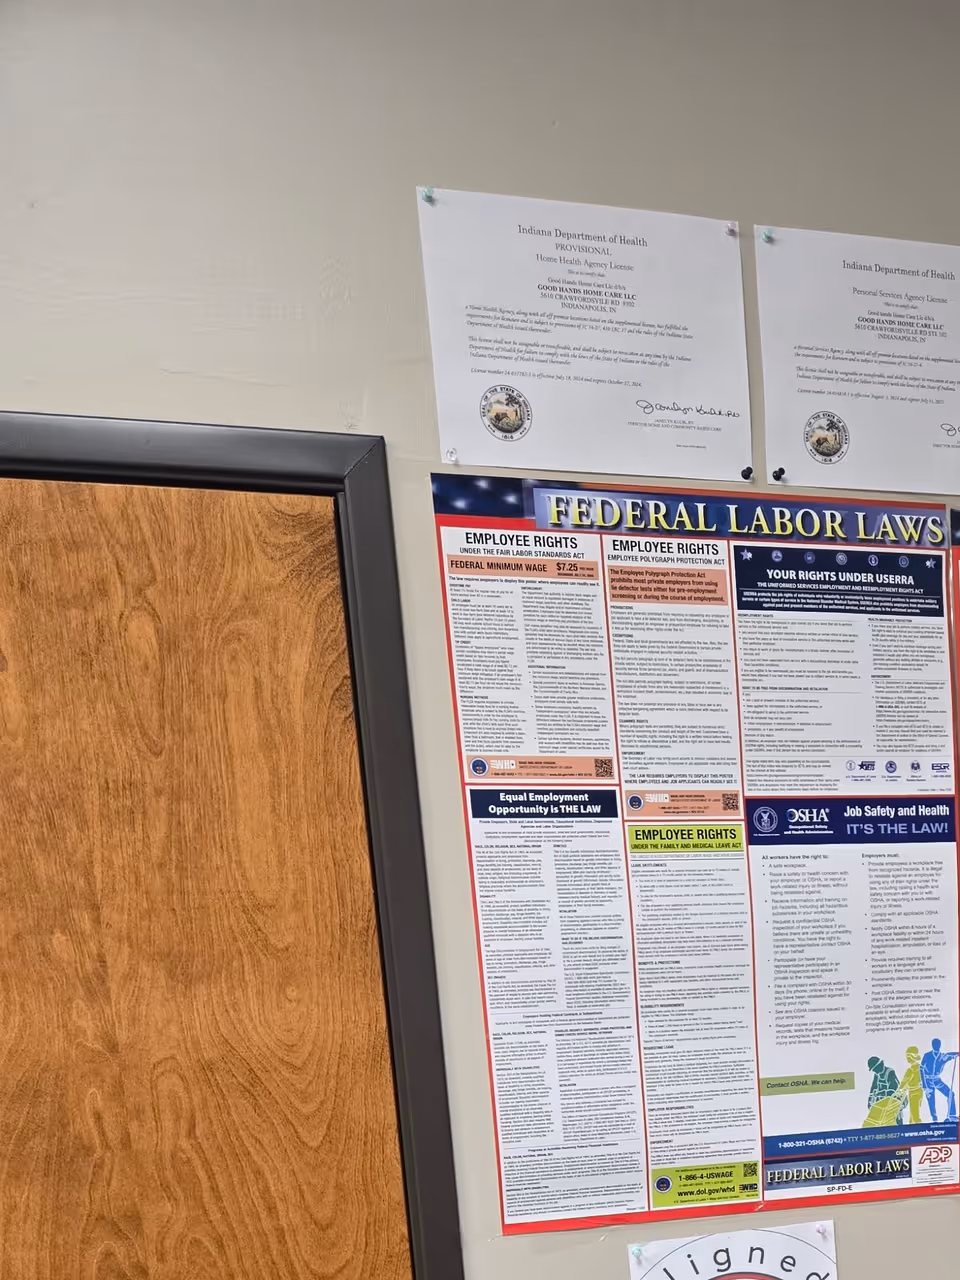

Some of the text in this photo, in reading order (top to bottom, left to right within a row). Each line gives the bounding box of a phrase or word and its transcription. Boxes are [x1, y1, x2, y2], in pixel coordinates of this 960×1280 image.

[518, 224, 648, 247] Indiana Department of Health
[555, 243, 612, 256] PROVISIONAL
[536, 254, 634, 271] Home Health Agency License
[842, 260, 956, 280] Indiana Department of Health
[537, 284, 558, 294] GOOD
[558, 286, 582, 294] HANDS
[583, 289, 603, 297] HOME
[852, 287, 948, 304] Personal Services Agency License
[548, 494, 944, 543] FEDERAL LABOR LAWS
[465, 532, 578, 549] EMPLOYEE RIGHTS
[612, 539, 719, 555] EMPLOYEE RIGHTS
[496, 548, 510, 558] FAIR
[512, 549, 533, 559] LABOR
[534, 551, 572, 559] STANDARDS
[608, 554, 638, 562] EMPLOYEE
[640, 555, 675, 563] POLYGRAPH
[676, 557, 712, 565] PROTECTION
[450, 560, 547, 572] FEDERAL MINIMUM WAGE
[556, 562, 578, 572] $7.25
[766, 569, 914, 585] YOUR RIGHTS UNDER USERRA
[500, 792, 589, 803] Equal Employment
[488, 802, 601, 816] Opportunity Is THE LAW
[786, 808, 829, 822] OSHA
[844, 805, 950, 818] Job Safety and Health
[635, 828, 736, 840] EMPLOYEE RIGHTS
[846, 822, 948, 835] IT'S THE LAW!
[778, 1139, 825, 1148] 1-800-321-OSHA
[918, 1146, 953, 1164] ADP
[678, 1171, 734, 1181] 1-866-4-USWAGE
[766, 1158, 910, 1184] FEDERAL LABOR LAWS
[677, 1186, 735, 1197] www.dol.gov/whd
